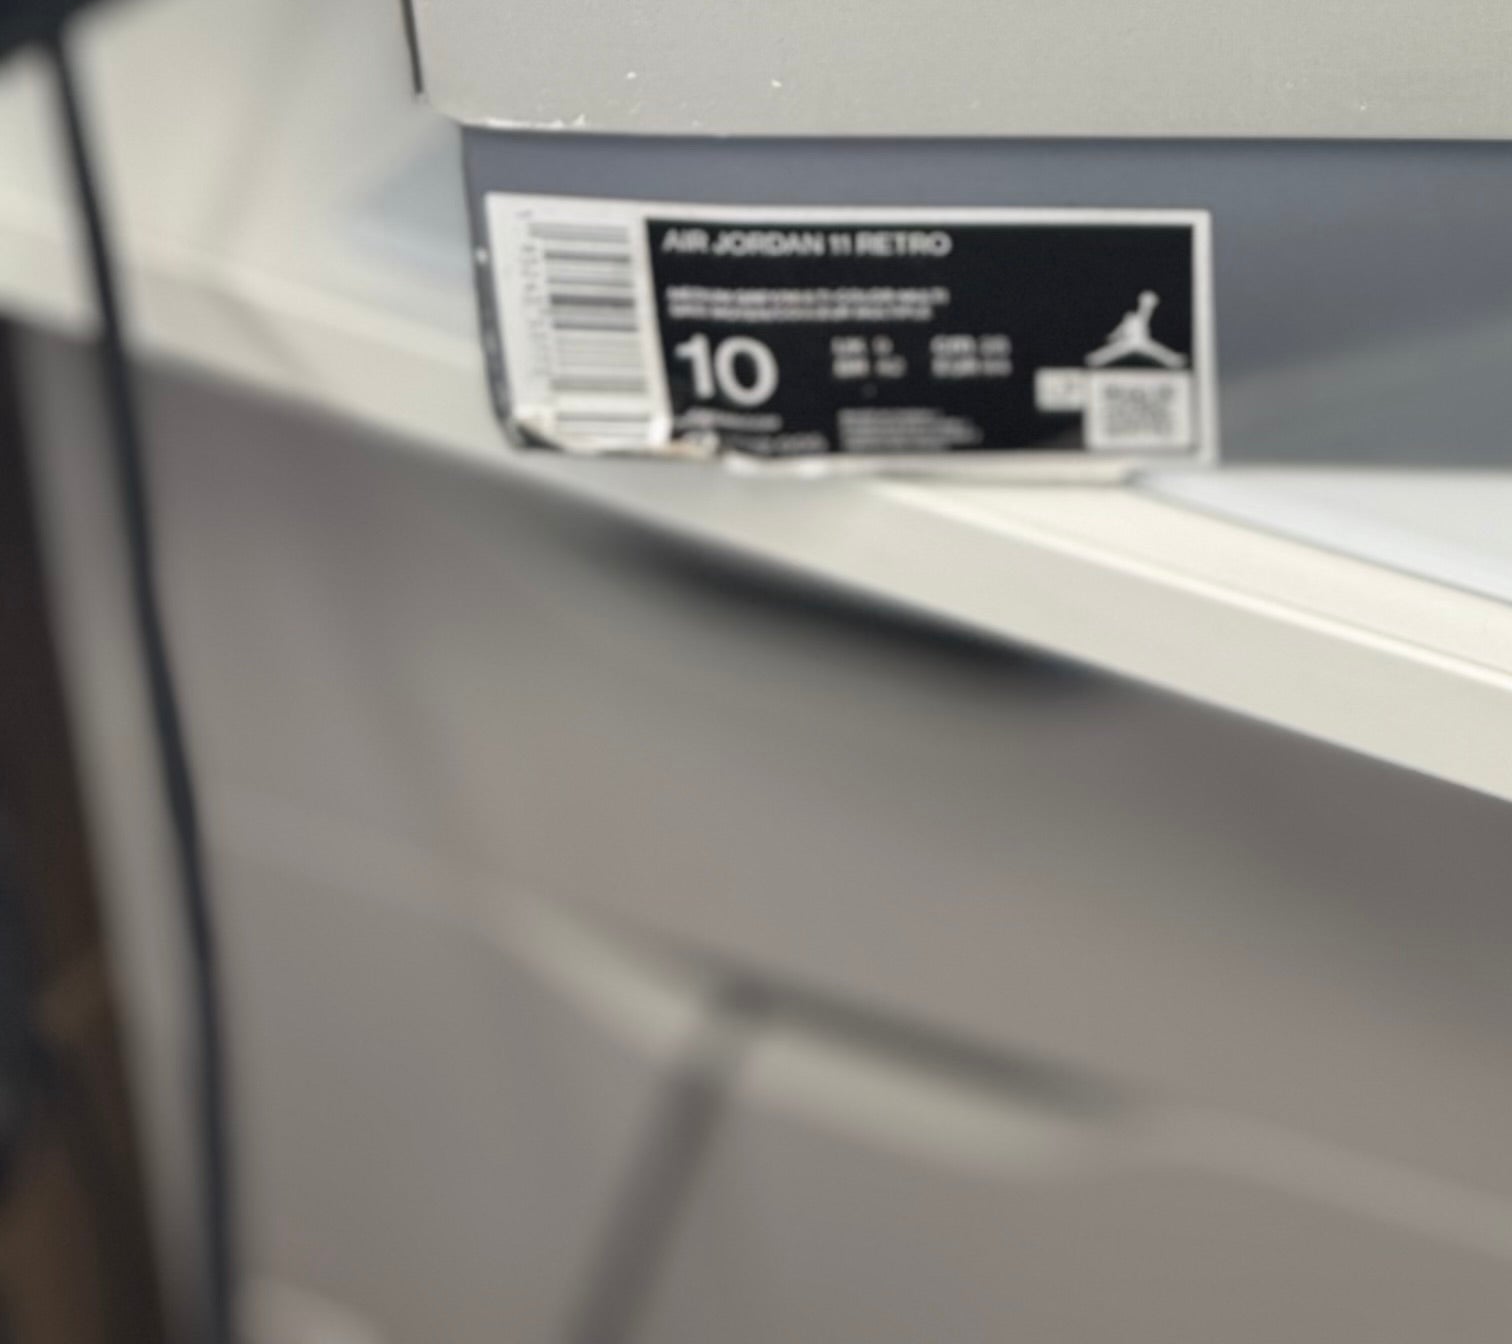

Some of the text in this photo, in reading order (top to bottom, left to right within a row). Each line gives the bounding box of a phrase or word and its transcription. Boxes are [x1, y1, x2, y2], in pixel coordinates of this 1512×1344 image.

[661, 227, 953, 257] AIR JORDAN 11 RETRO
[674, 333, 779, 407] 10
